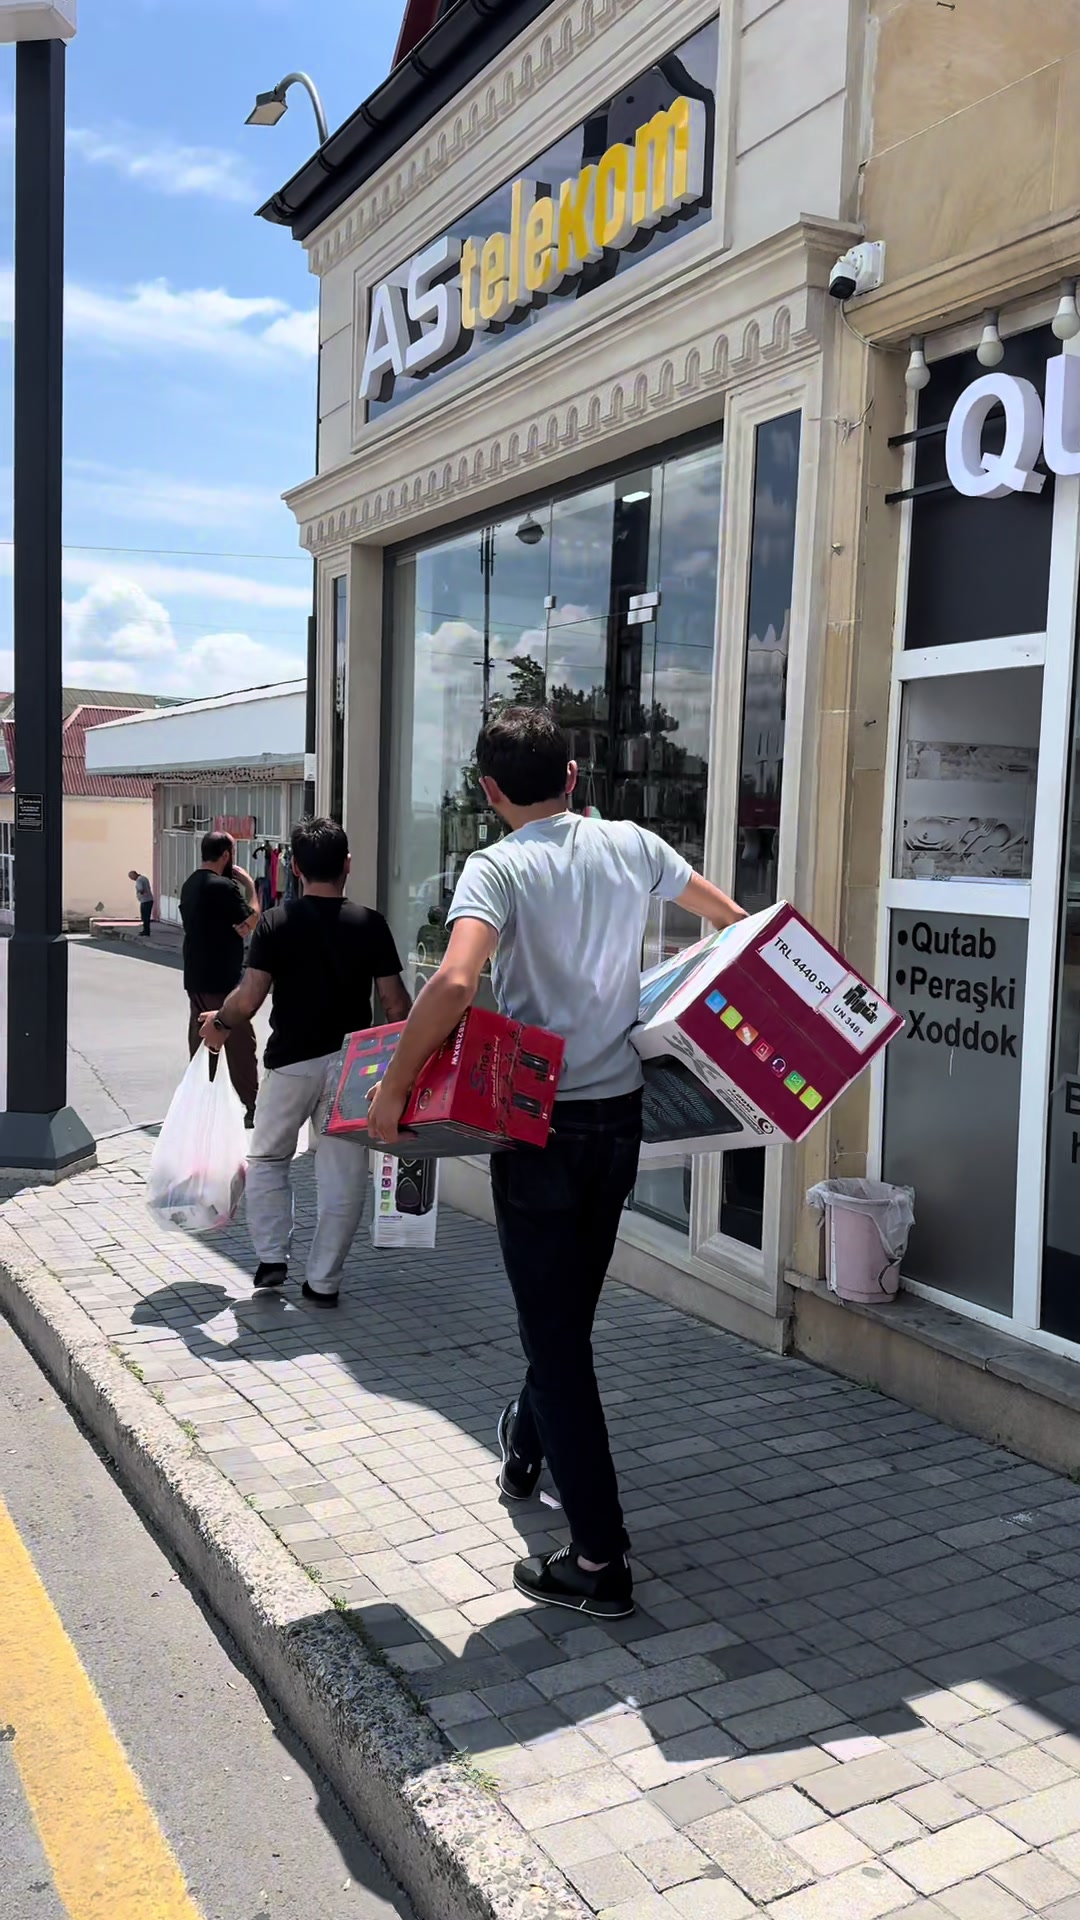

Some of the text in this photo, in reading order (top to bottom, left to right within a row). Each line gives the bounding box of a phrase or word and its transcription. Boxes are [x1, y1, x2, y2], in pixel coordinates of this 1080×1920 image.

[911, 921, 996, 959] Qutab
[774, 937, 831, 995] TRL 4440 SP
[909, 966, 1016, 1013] Peraşki
[833, 1004, 864, 1037] UN 3481
[907, 1009, 1017, 1059] Xoddok
